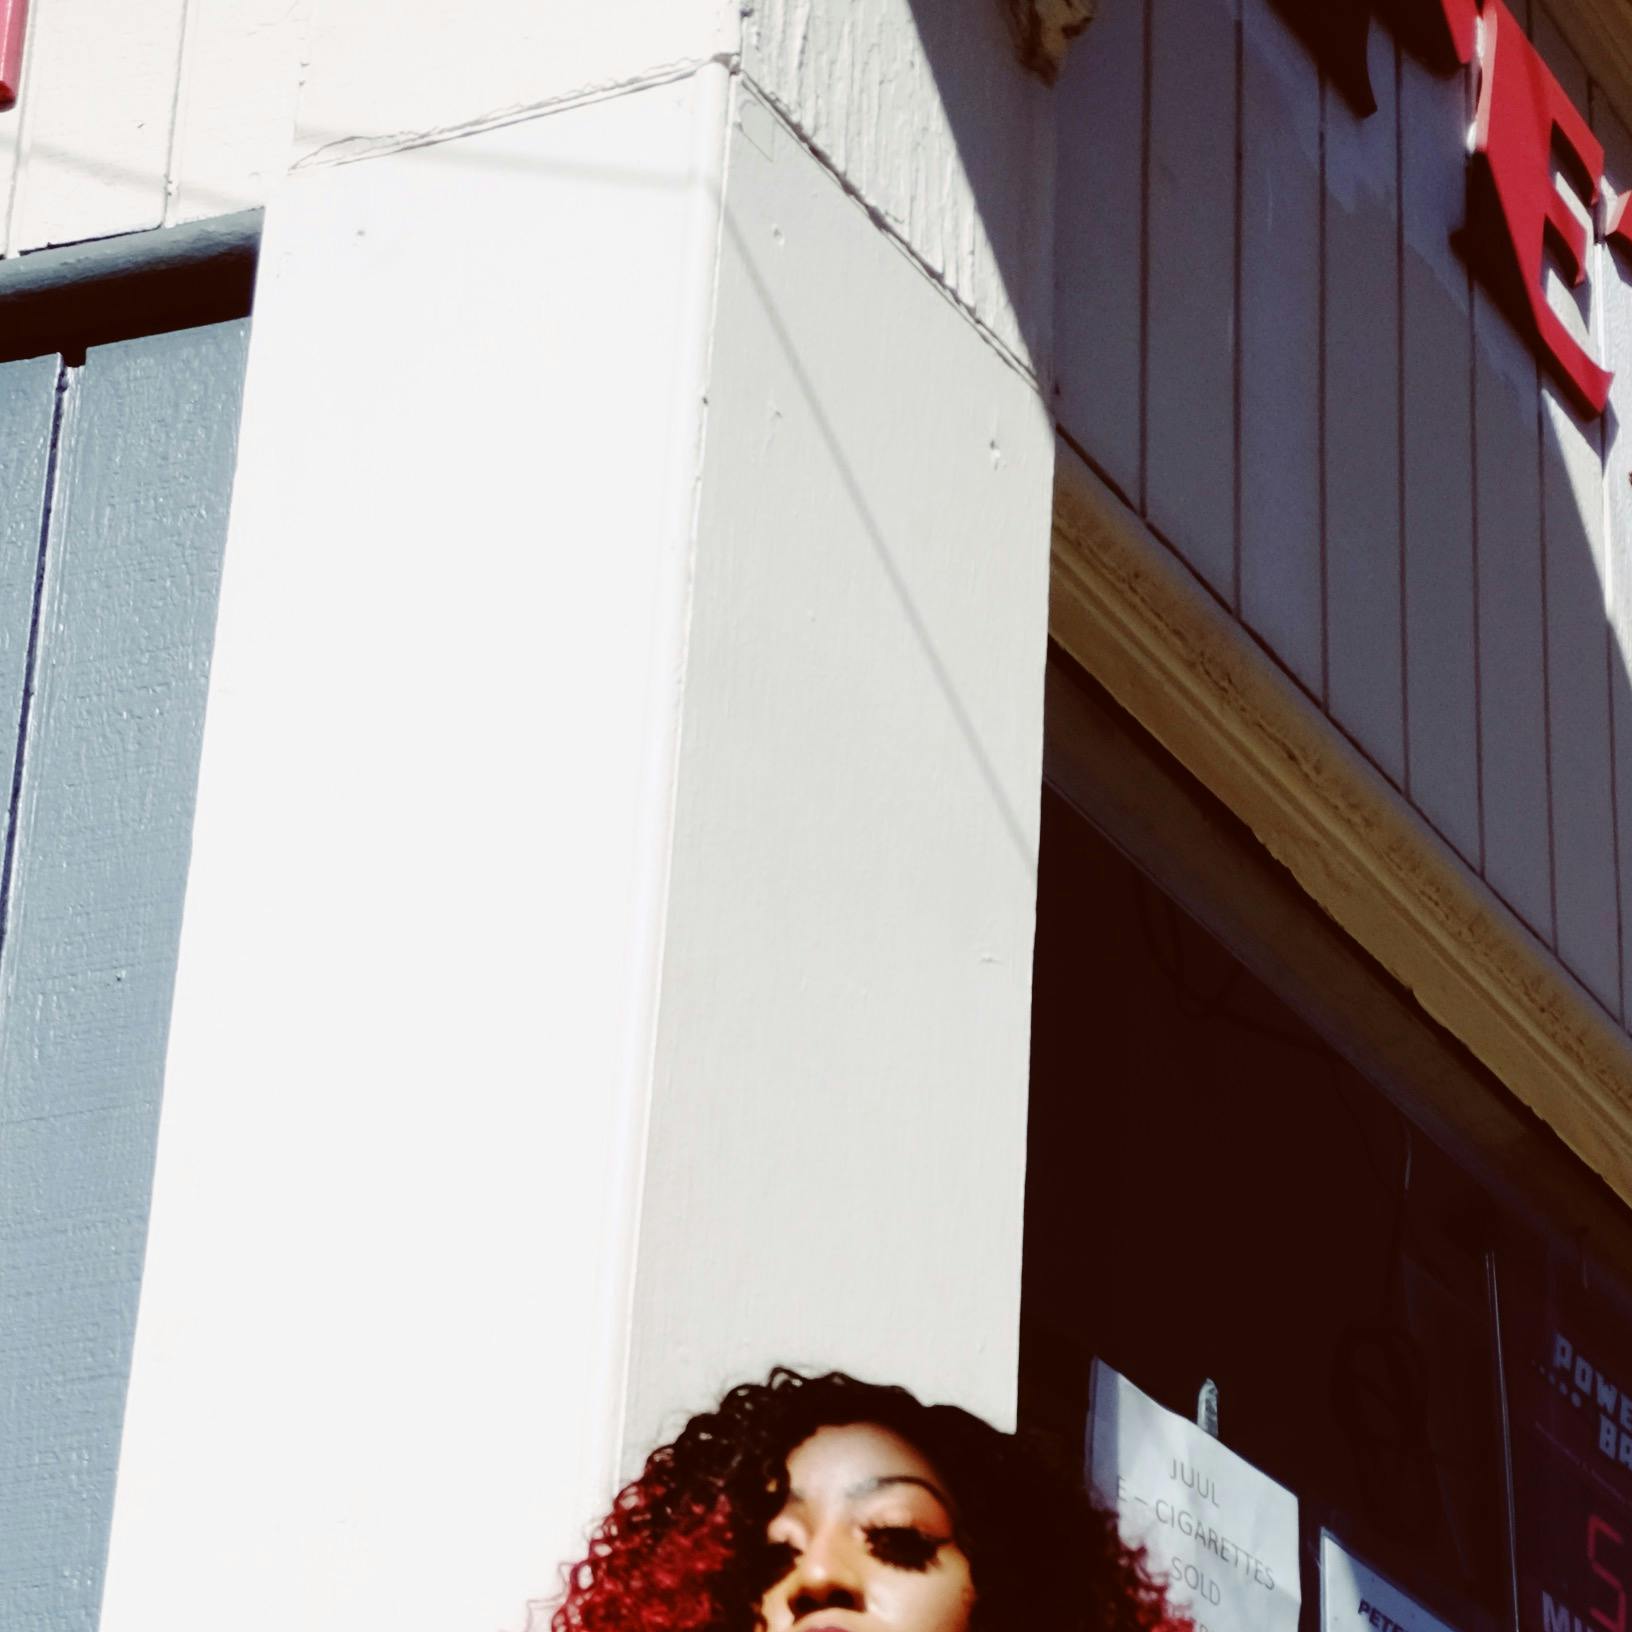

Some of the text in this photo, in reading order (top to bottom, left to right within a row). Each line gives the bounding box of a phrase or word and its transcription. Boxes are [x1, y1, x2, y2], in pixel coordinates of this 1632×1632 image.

[1169, 1458, 1221, 1509] JUUL
[1154, 1498, 1277, 1592] CIGARETTES
[1171, 1555, 1221, 1607] SOLD
